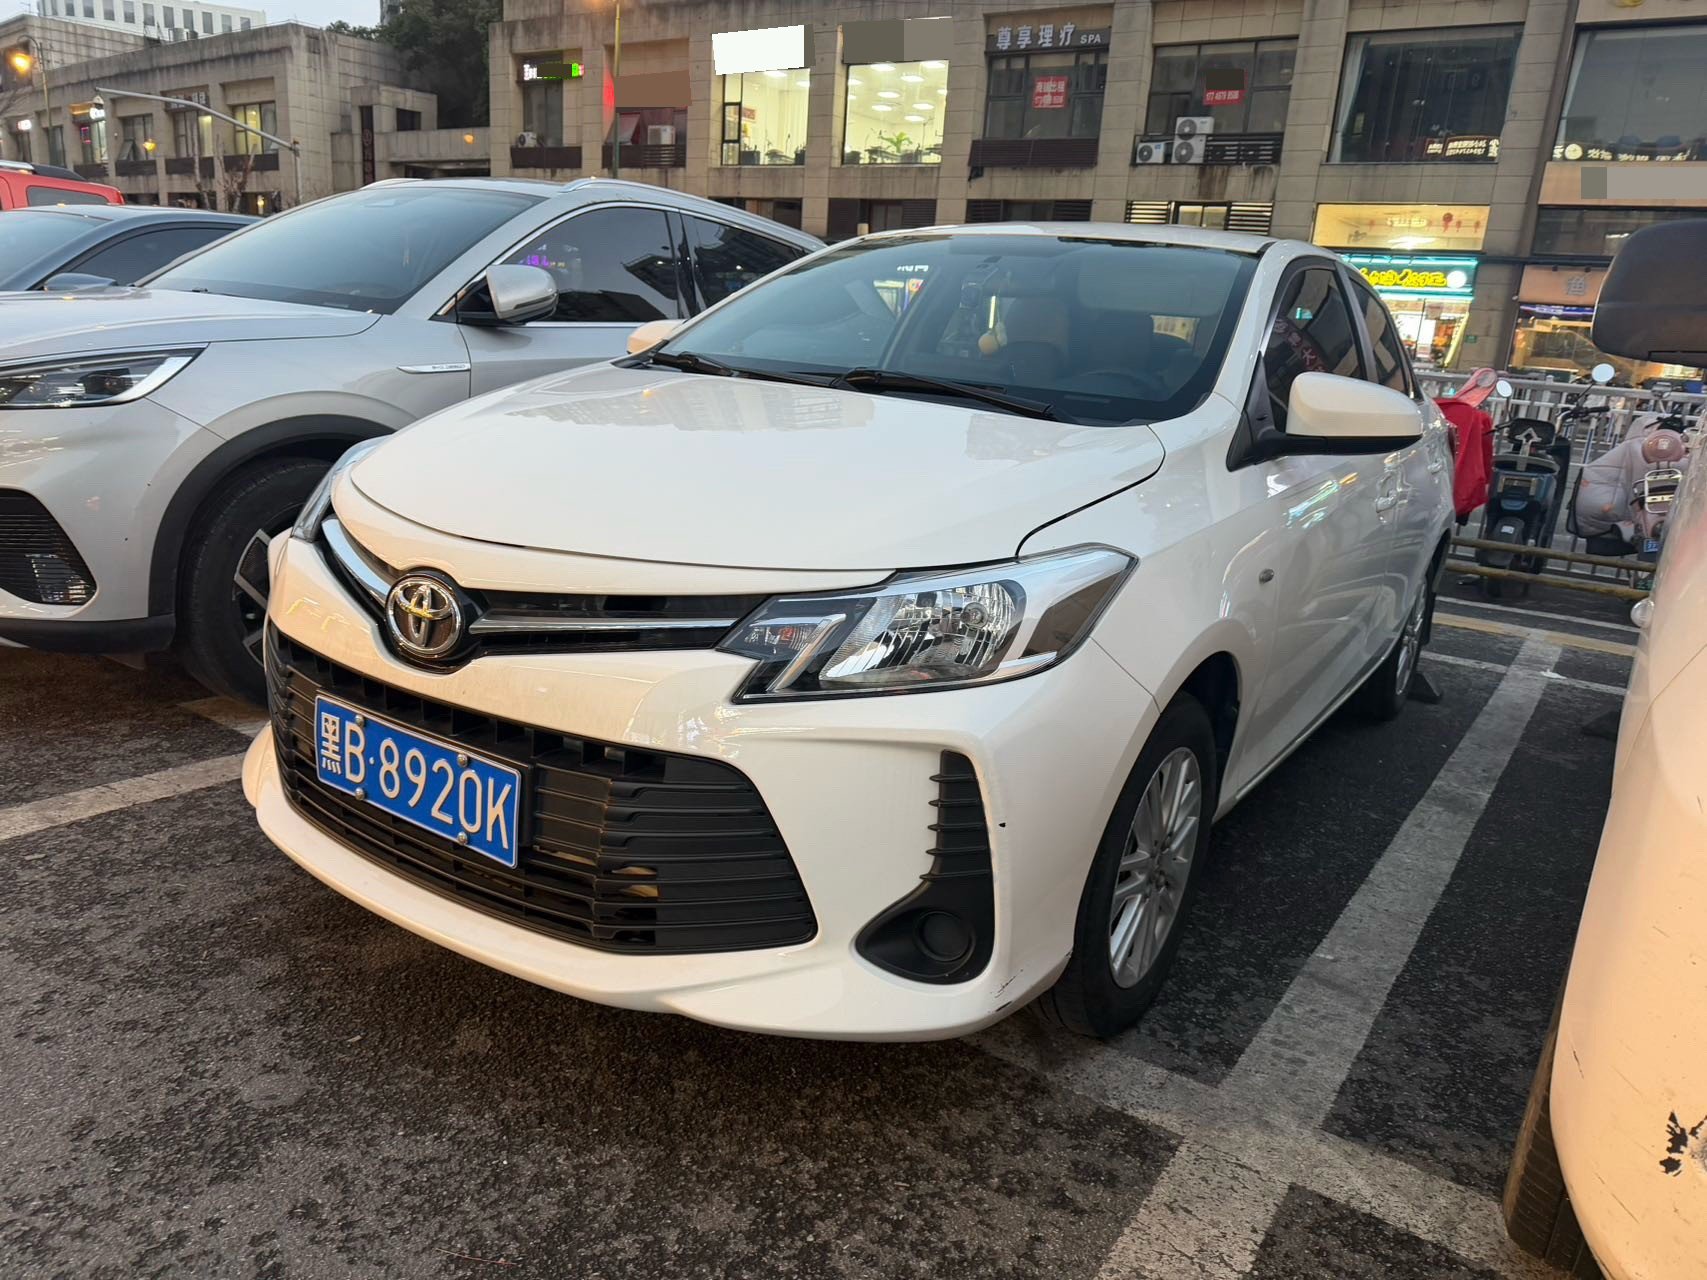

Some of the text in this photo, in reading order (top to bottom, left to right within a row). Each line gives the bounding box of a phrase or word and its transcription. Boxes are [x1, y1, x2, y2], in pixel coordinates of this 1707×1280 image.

[996, 22, 1102, 50] 尊享理疗 SPA
[321, 711, 512, 850] 黑B·8920K
